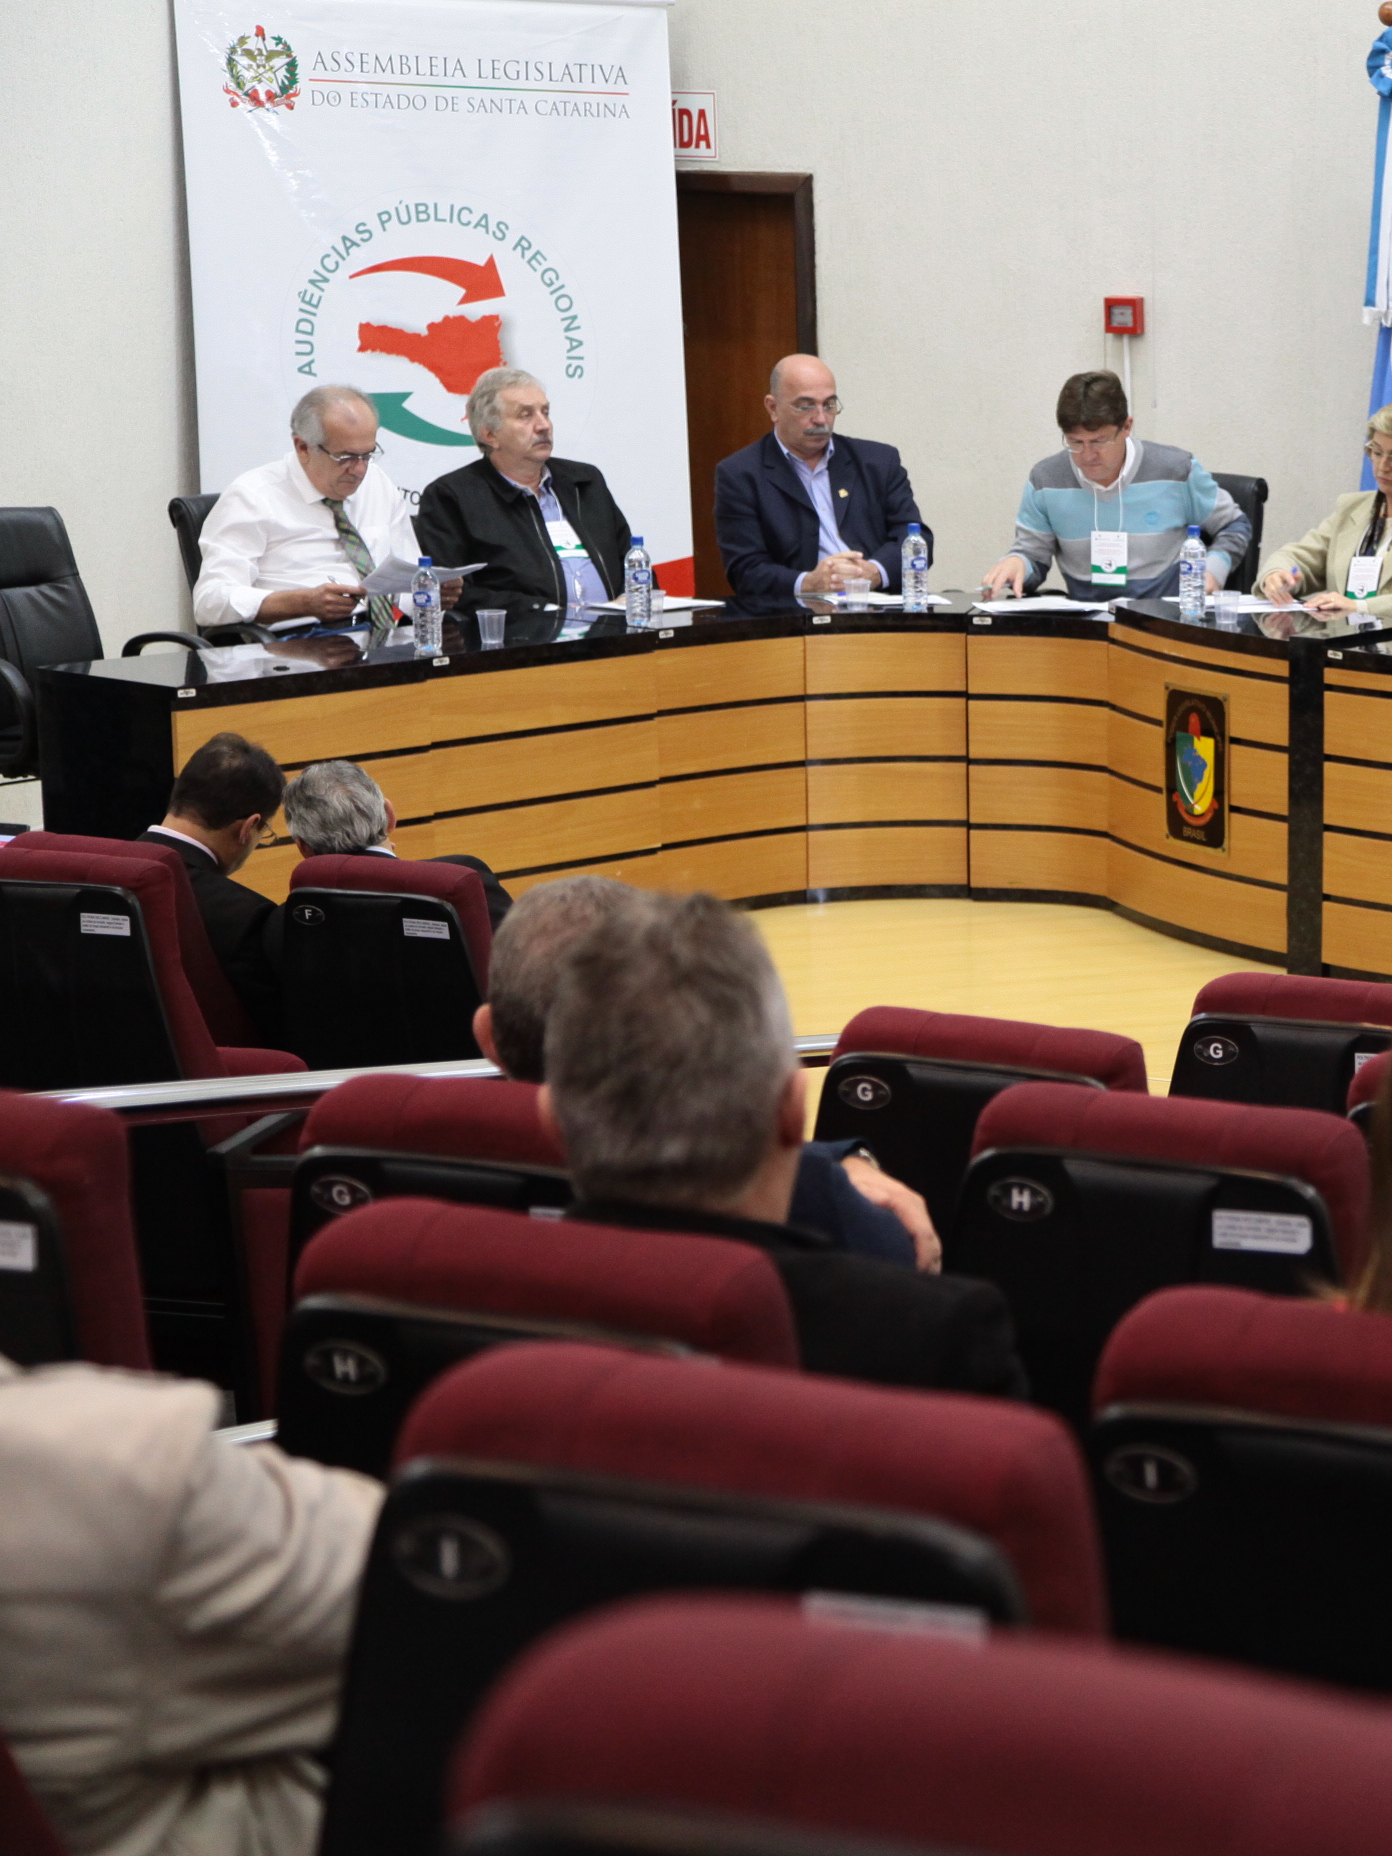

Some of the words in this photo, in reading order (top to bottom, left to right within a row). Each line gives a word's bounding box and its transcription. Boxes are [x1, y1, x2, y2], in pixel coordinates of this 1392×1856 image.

[311, 50, 467, 79] ASSEMBLEIA
[476, 58, 629, 86] LEGISLATIVA
[310, 89, 342, 107] DO
[350, 91, 427, 111] ESTADO
[434, 95, 459, 113] DE
[466, 97, 528, 116] SANTA
[534, 99, 631, 119] CATARINA
[671, 99, 712, 150] ÍDA
[294, 221, 374, 378] AUDIÊNCIAS
[377, 200, 510, 242] PÚBLICAS
[512, 235, 585, 380] REGIONAIS
[304, 909, 313, 920] F
[1209, 1042, 1224, 1059] G
[856, 1082, 874, 1102] G
[331, 1184, 352, 1206] G
[1010, 1186, 1031, 1212] H
[333, 1353, 358, 1382] H
